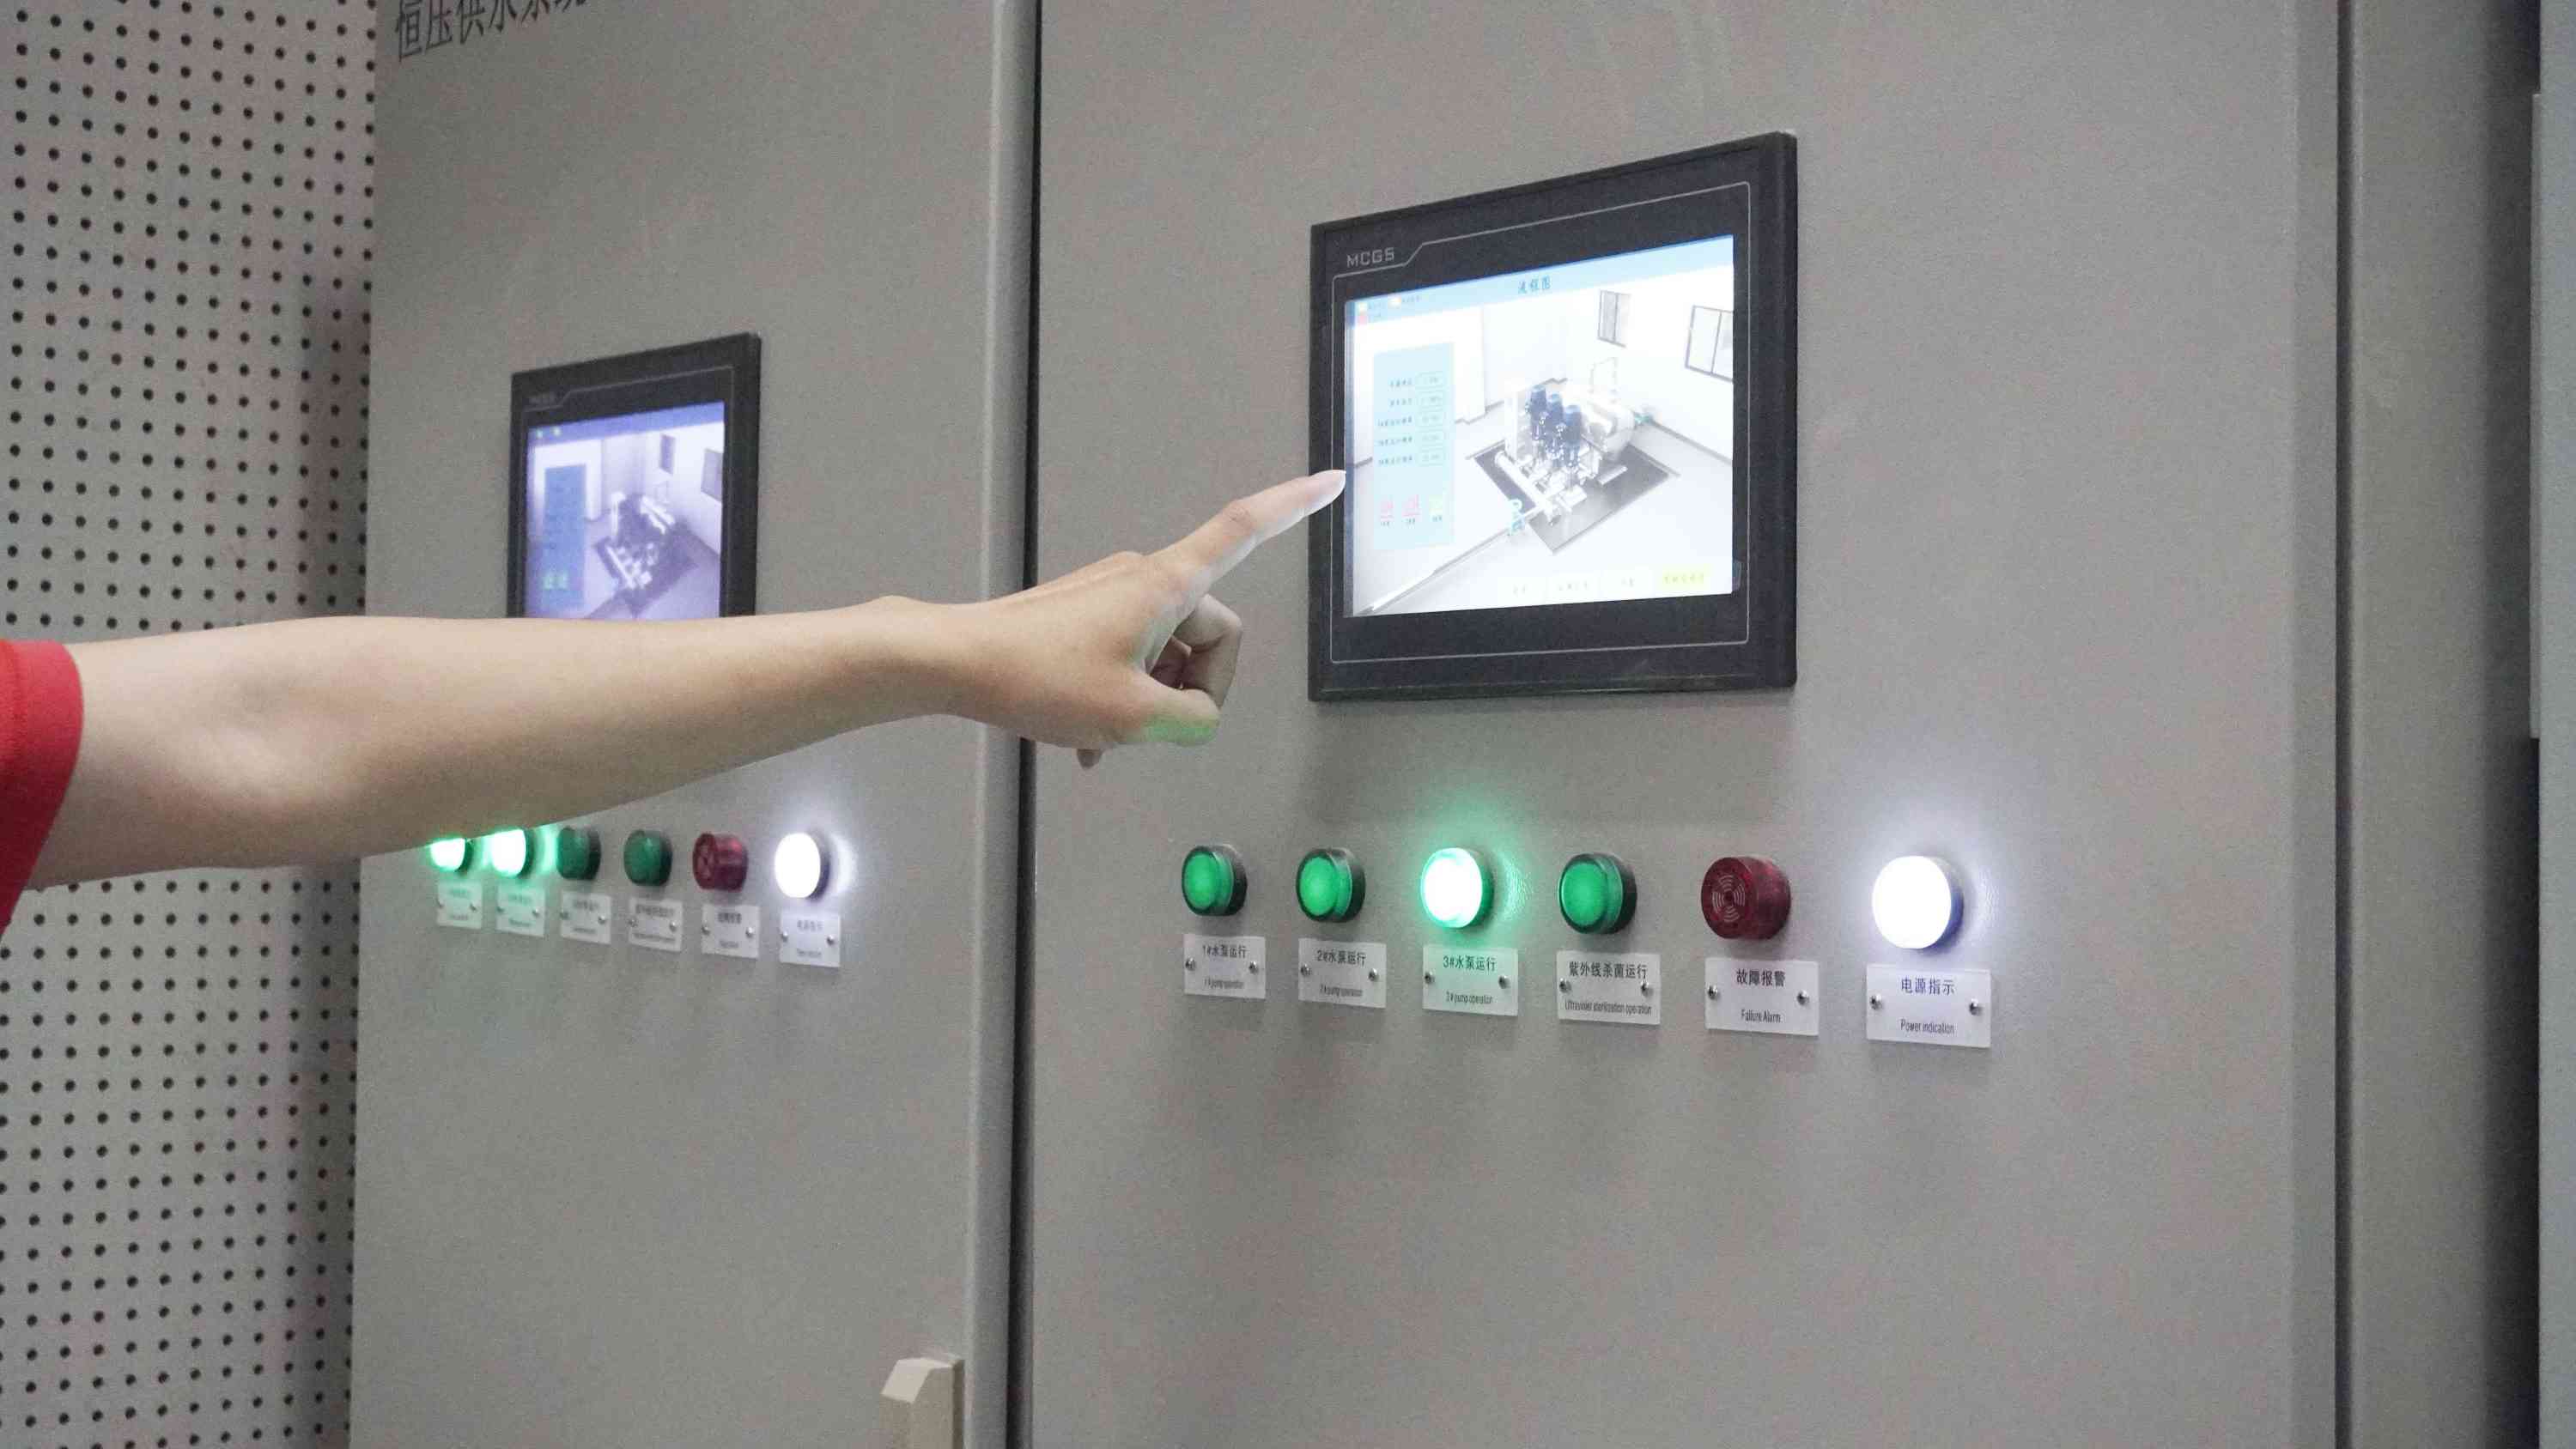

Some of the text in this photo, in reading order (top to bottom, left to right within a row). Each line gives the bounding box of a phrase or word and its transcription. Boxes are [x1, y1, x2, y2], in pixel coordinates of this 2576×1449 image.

[1346, 246, 1395, 268] MCGS
[1443, 955, 1497, 972] 3#水泵运行
[1569, 961, 1648, 979] 紫外线杀菌运行
[1736, 968, 1785, 987] 故障报警
[1901, 977, 1955, 996] 电源指示
[1741, 1007, 1782, 1023] Failure Alarm
[1900, 1018, 1955, 1035] Power indication
